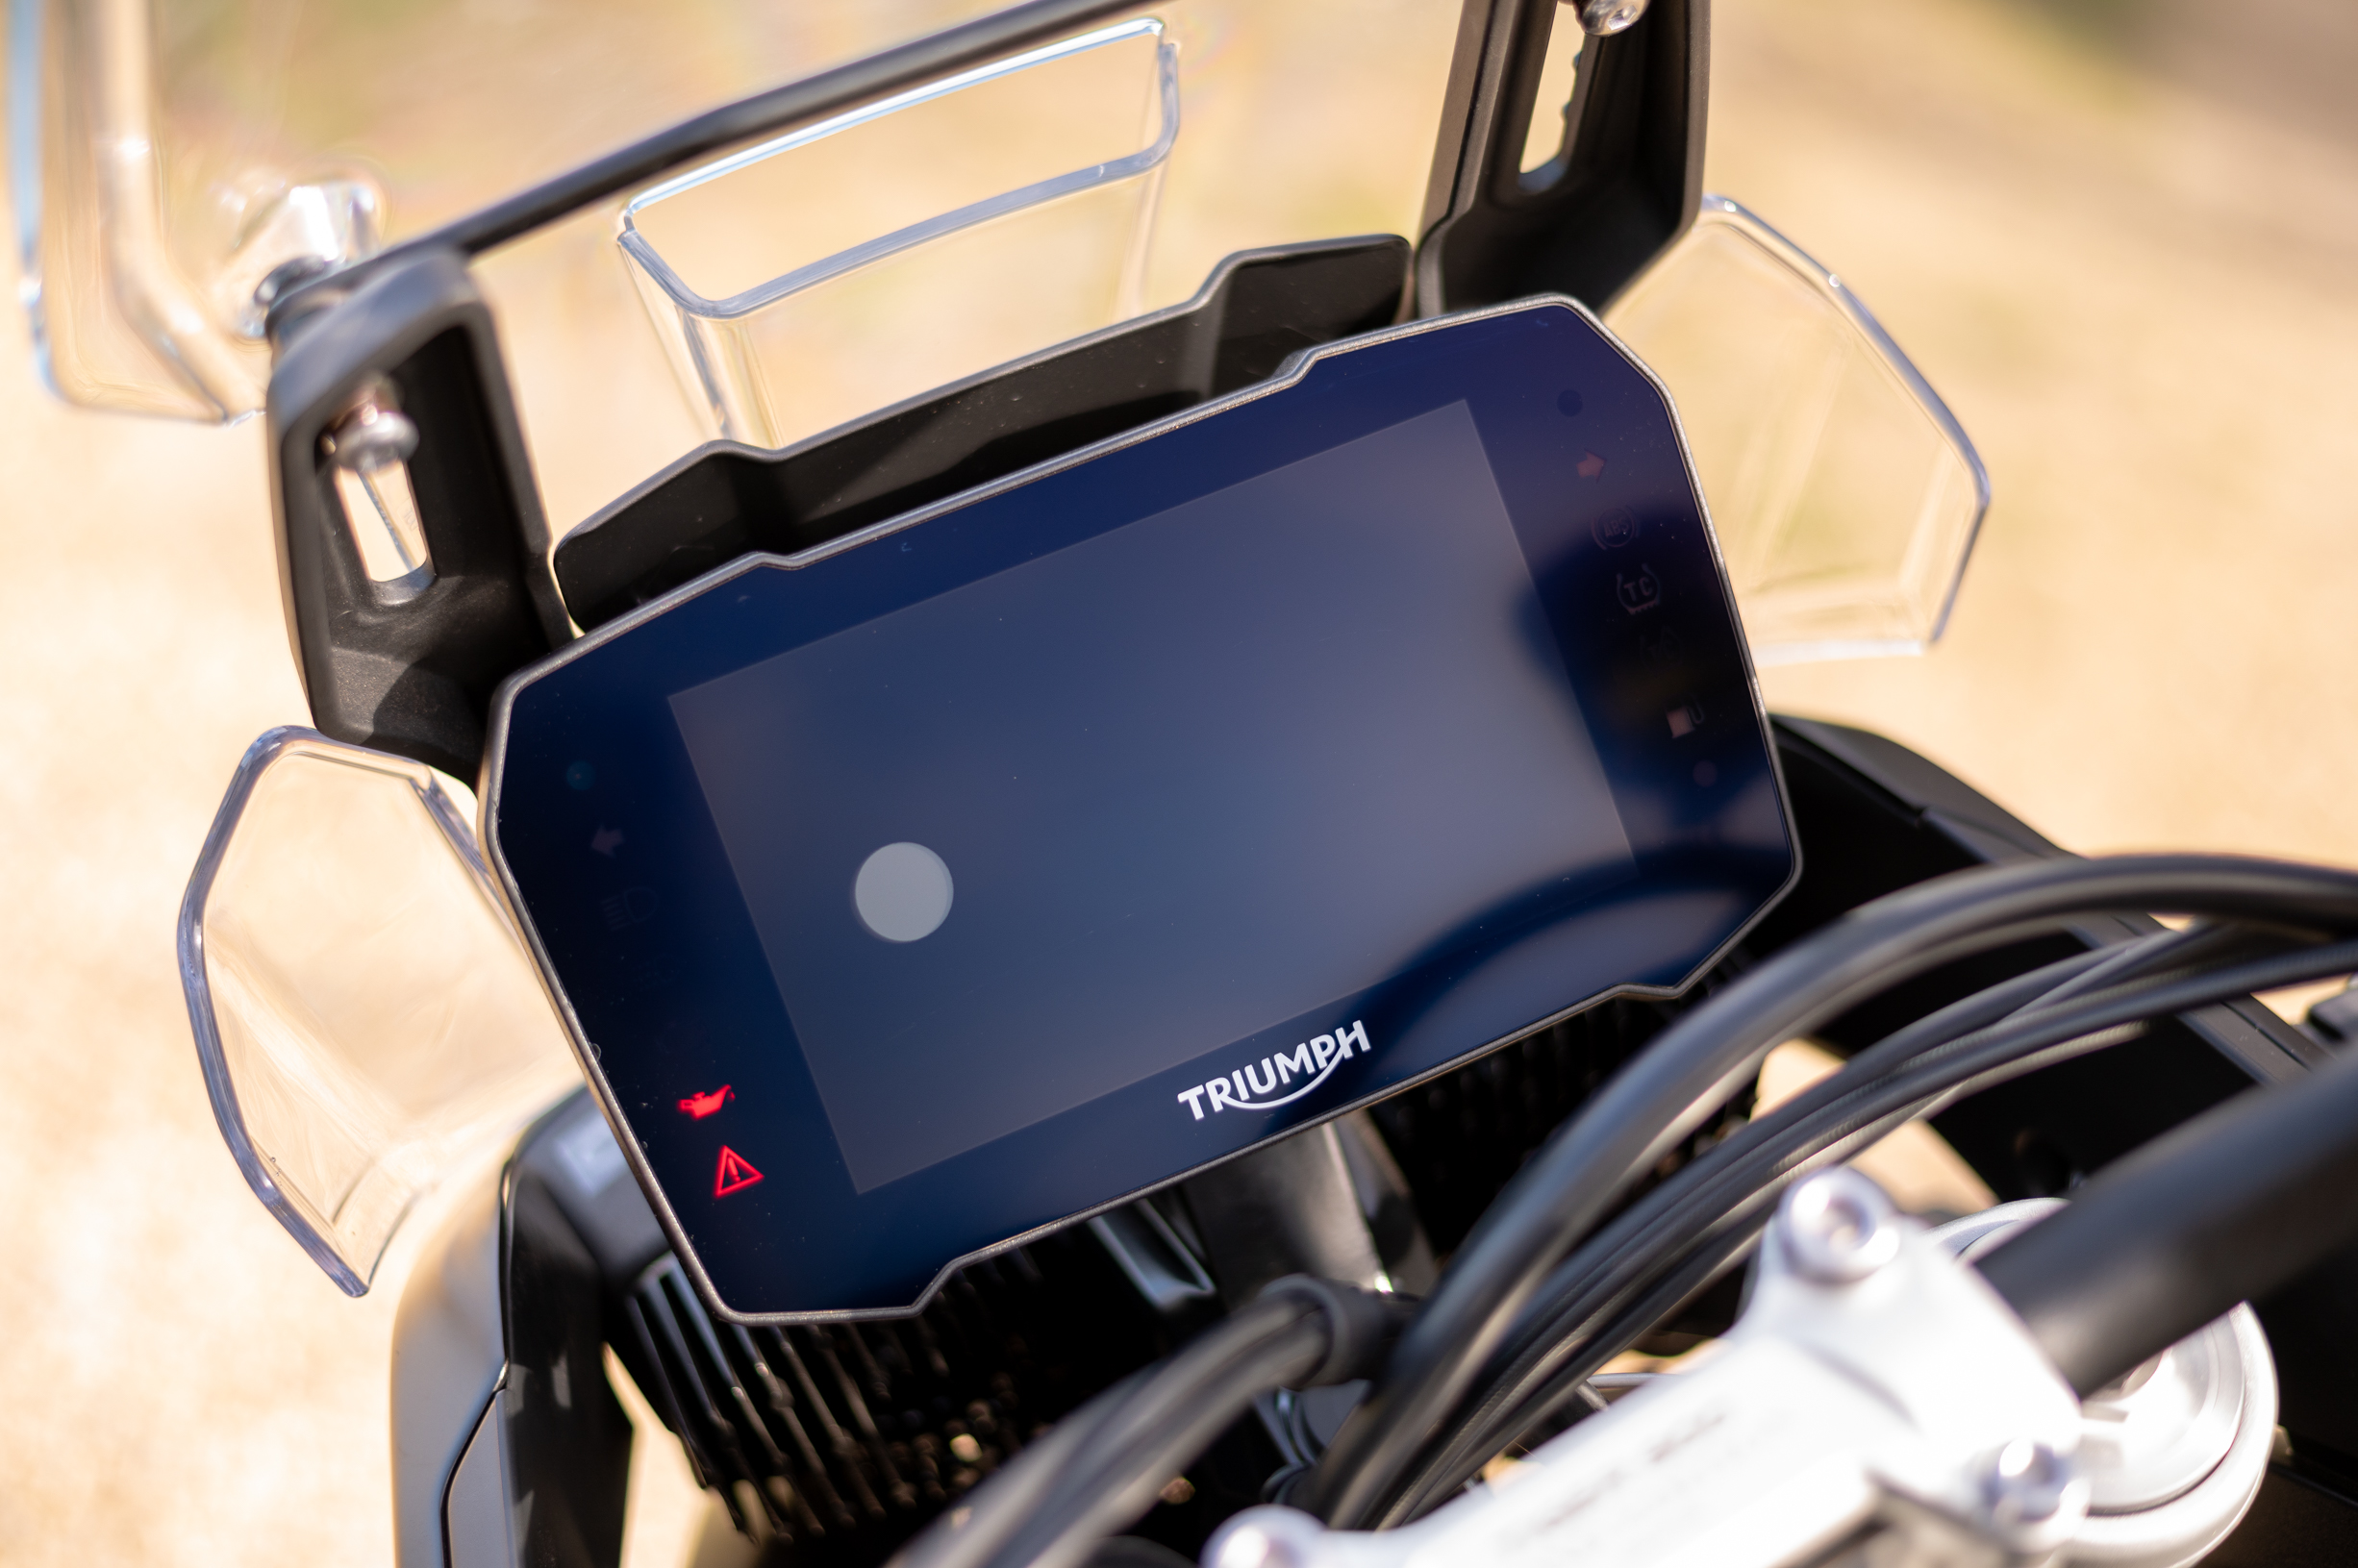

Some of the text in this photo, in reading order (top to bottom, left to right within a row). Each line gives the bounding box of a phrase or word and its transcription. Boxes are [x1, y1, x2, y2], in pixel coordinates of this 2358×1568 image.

[1602, 516, 1630, 538] ABS
[1623, 577, 1653, 602] TC
[1177, 1019, 1372, 1121] TRIUMPH
